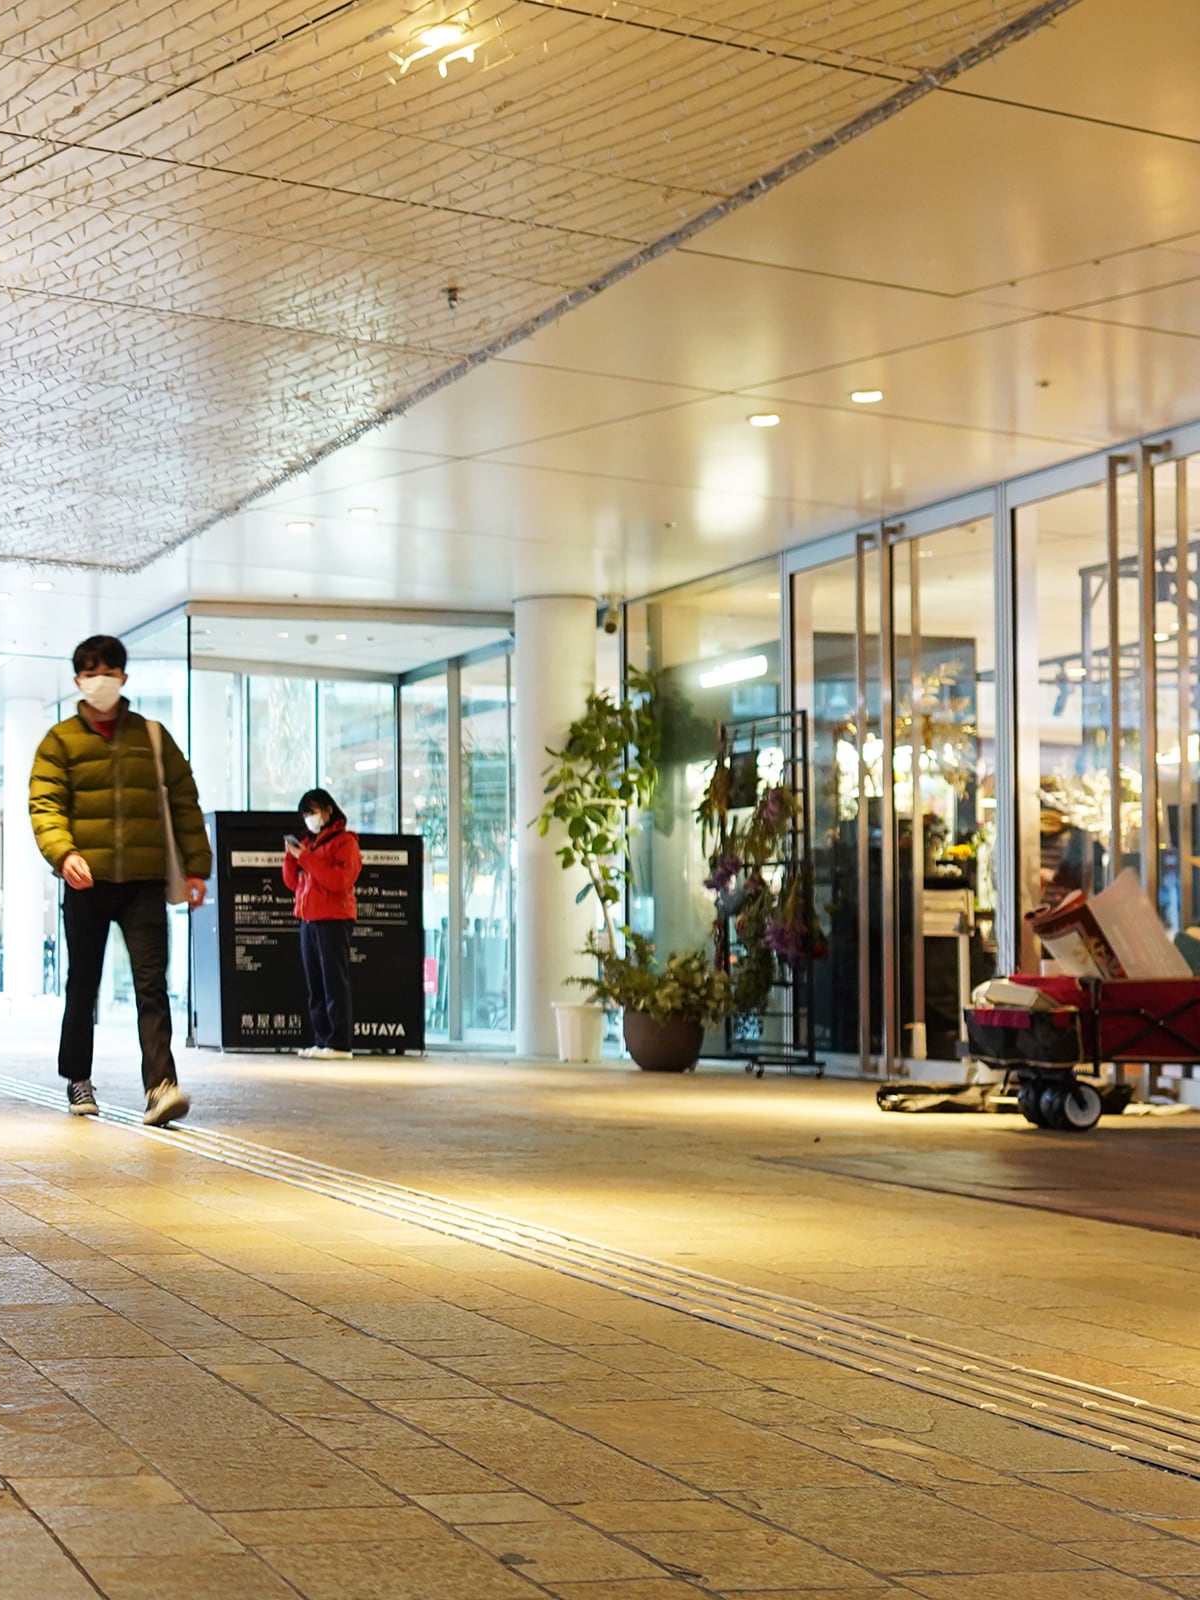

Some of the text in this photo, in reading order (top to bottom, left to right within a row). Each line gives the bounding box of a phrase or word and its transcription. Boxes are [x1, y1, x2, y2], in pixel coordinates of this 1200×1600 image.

[354, 887, 379, 897] ボックス
[353, 1022, 406, 1037] SUTAYA
